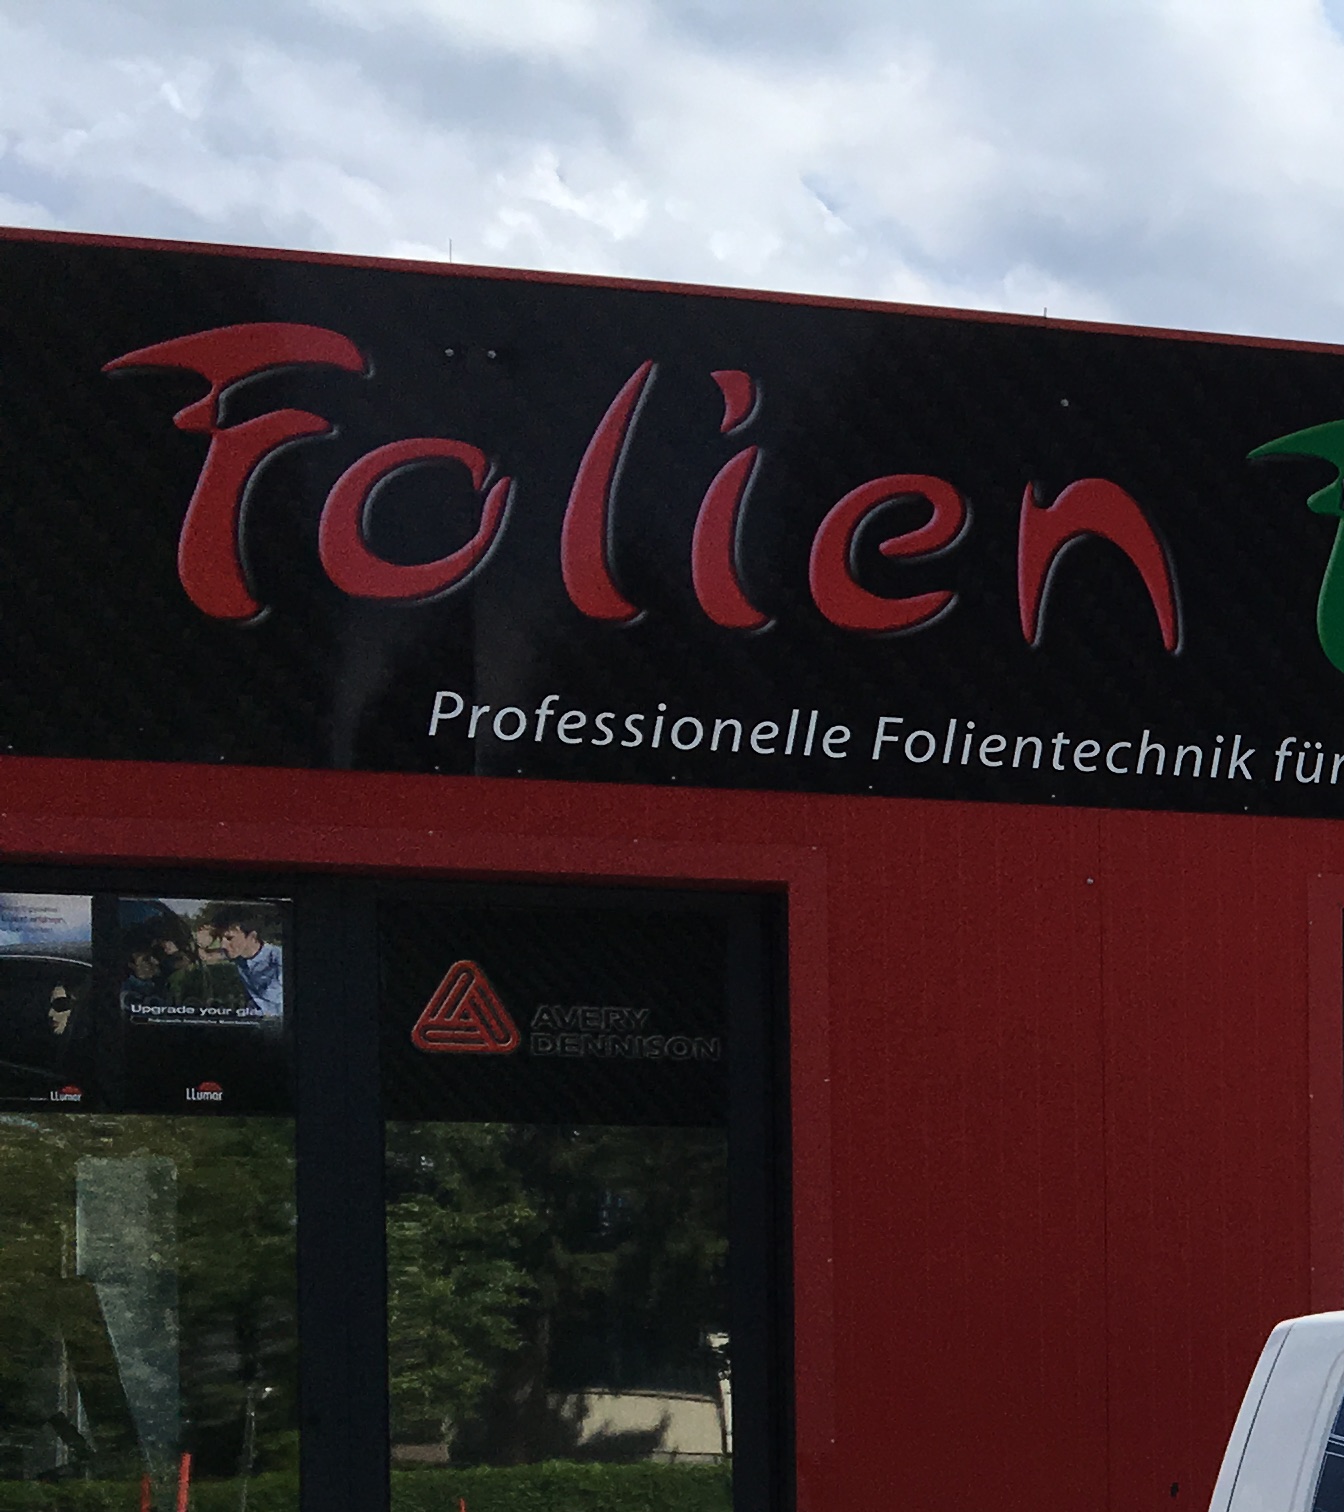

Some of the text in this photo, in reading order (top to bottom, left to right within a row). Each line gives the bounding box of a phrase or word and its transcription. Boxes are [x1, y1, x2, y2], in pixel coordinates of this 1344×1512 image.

[102, 321, 1184, 655] Folien
[427, 690, 850, 759] Professionelle
[871, 716, 1256, 782] Folientechnik
[131, 1003, 195, 1016] Upgrade
[199, 1005, 233, 1017] your
[531, 1004, 651, 1032] AVERY
[530, 1032, 720, 1061] DENNISON
[186, 1087, 224, 1101] LLumar
